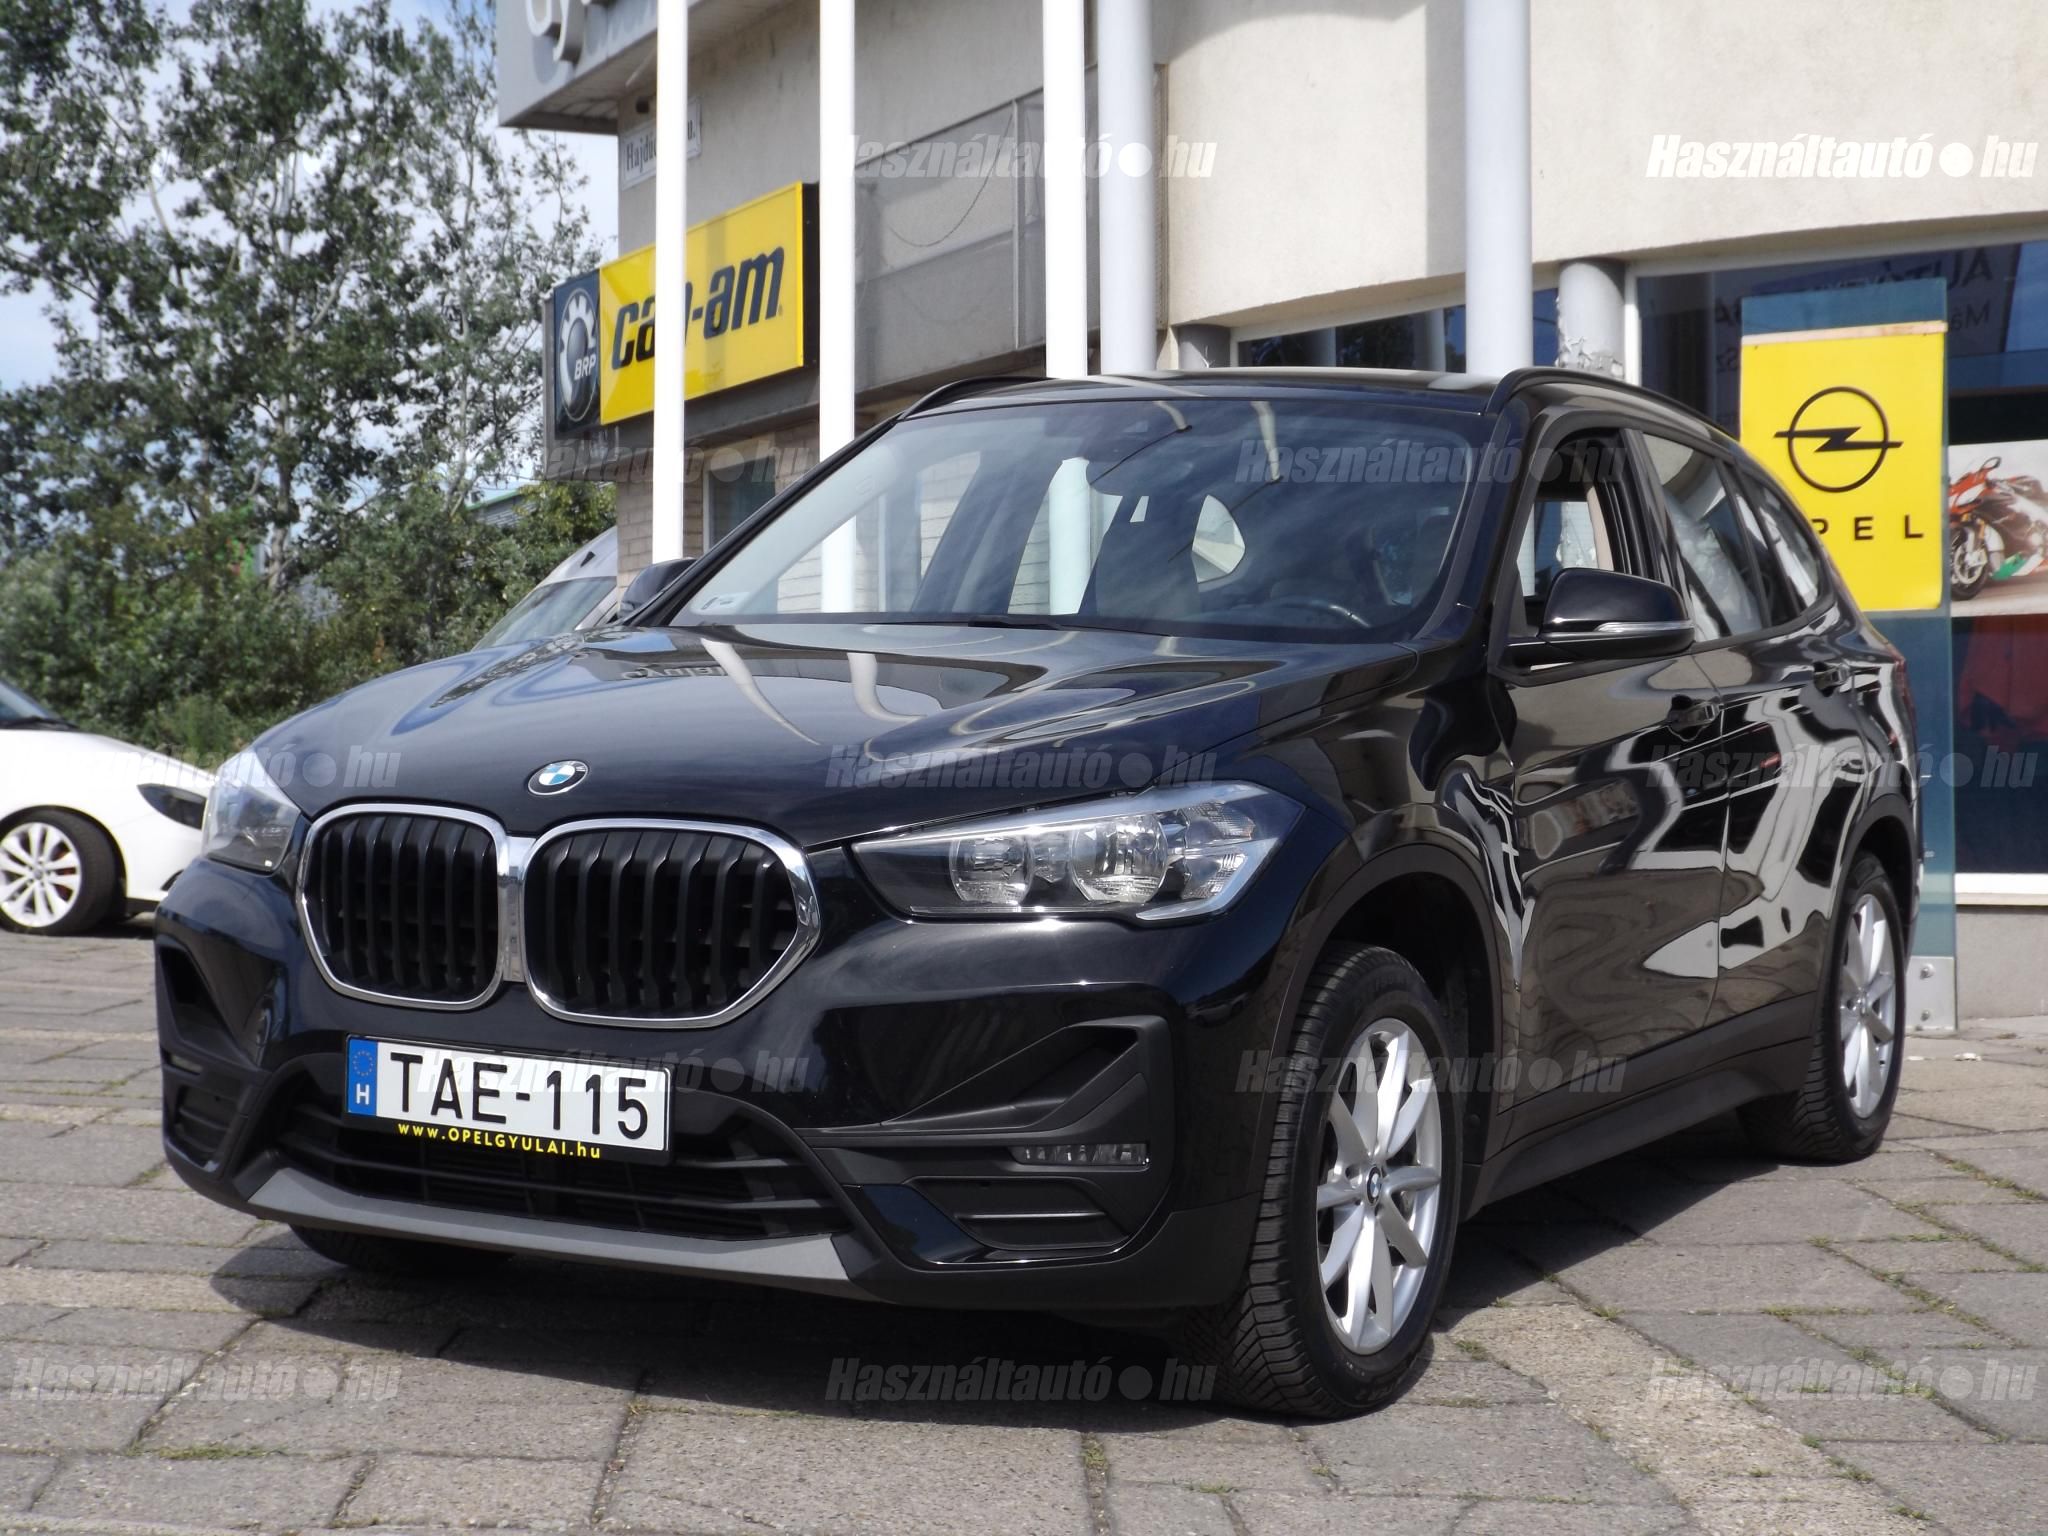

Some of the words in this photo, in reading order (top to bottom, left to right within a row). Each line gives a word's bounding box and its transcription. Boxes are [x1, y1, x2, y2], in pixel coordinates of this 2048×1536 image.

[574, 353, 597, 380] BRP
[356, 1083, 370, 1106] H
[390, 1051, 648, 1140] TAE-115
[398, 1122, 600, 1160] www.OPELGYULAI.hu
